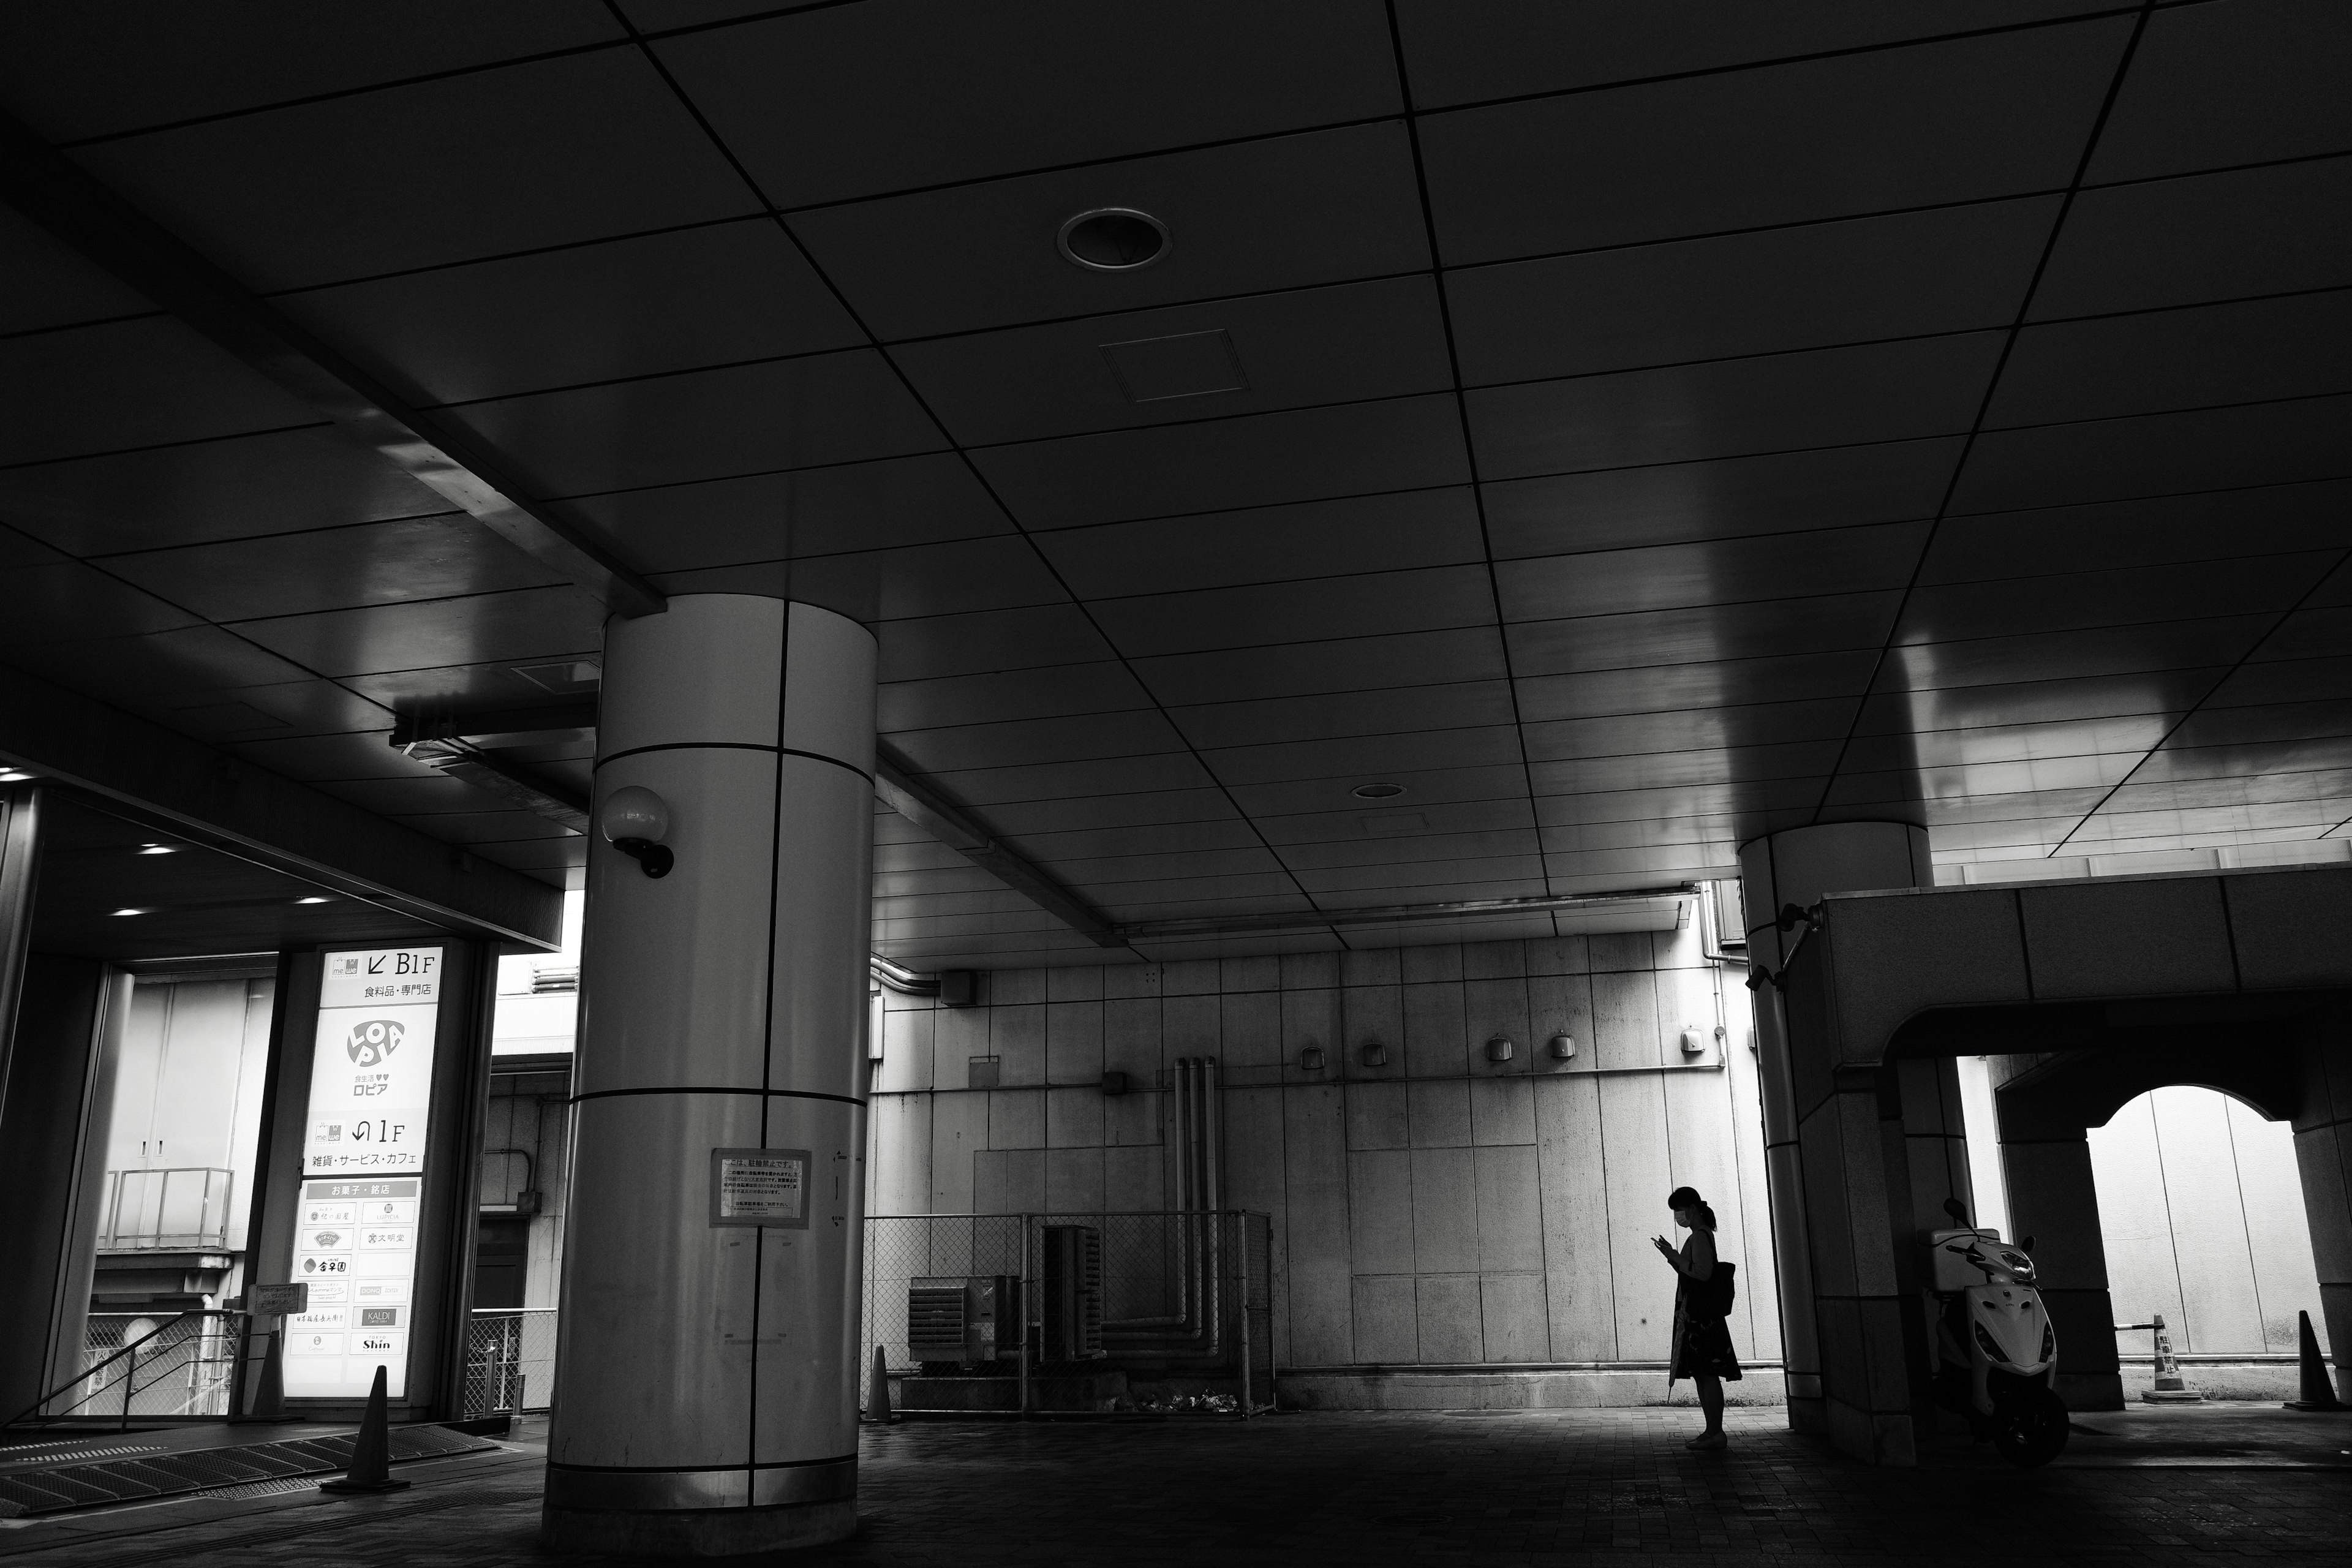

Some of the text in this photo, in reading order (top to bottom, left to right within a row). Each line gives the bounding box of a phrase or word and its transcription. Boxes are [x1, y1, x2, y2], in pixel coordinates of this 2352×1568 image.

[395, 952, 435, 975] B1F
[364, 984, 432, 998] 食料品・専門店
[355, 1074, 375, 1083] 食生活
[353, 1084, 388, 1096] ロピア
[379, 1120, 405, 1142] 1F
[312, 1153, 417, 1167] 雑貨・サービス・カフェ
[725, 1159, 793, 1168] ここは、駐輪禁止です。
[331, 1185, 390, 1196] お菓子・銘店
[378, 1234, 405, 1242] 文明堂
[317, 1261, 347, 1272] 金子園
[368, 1311, 390, 1320] KALDI
[363, 1340, 390, 1349] Shin
[2160, 1336, 2175, 1374] 駐車禁止
